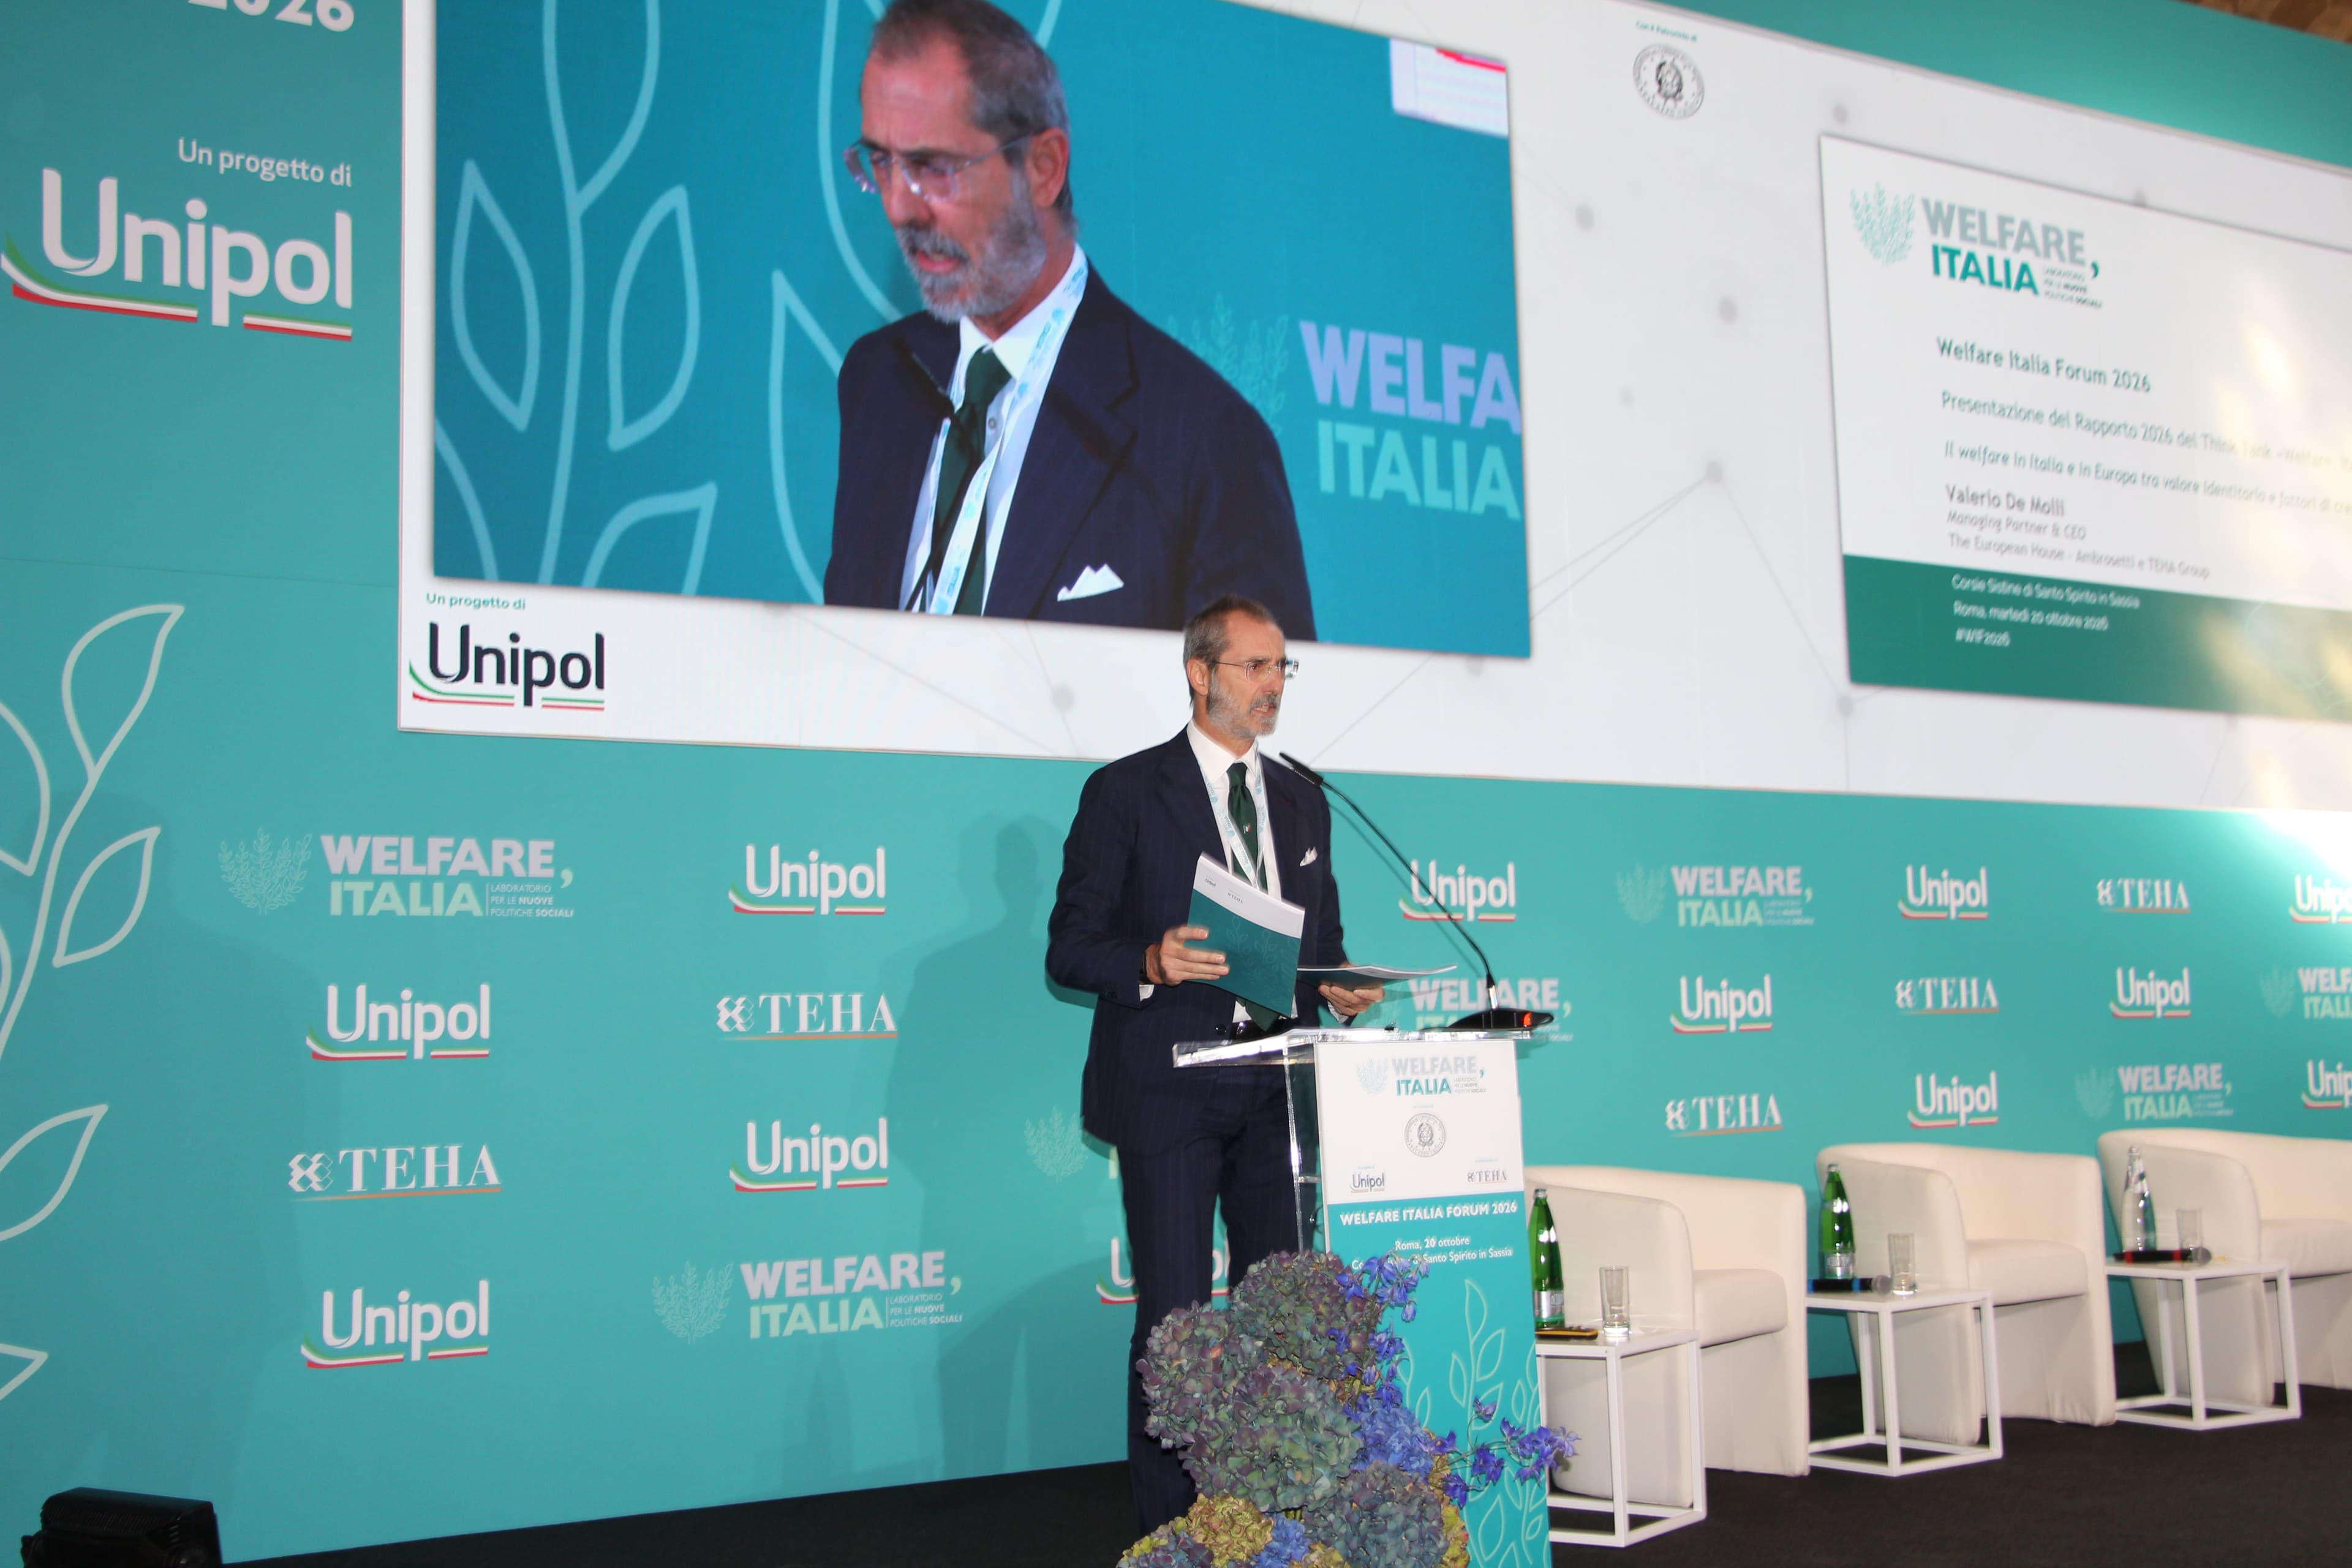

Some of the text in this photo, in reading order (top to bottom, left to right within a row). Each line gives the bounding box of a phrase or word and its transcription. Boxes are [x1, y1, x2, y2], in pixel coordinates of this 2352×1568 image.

[179, 137, 352, 187] Un progetto di
[42, 167, 352, 326] Unipol
[1932, 243, 2040, 296] ITALIA
[1937, 337, 2151, 393] Welfare Italia Forum 2026
[1942, 391, 2044, 425] Presentazione
[2049, 407, 2071, 429] del
[2075, 412, 2138, 441] Rapporto
[2177, 429, 2198, 450] del
[1317, 419, 1521, 521] ITALIA
[1958, 443, 2009, 467] welfare
[2013, 451, 2026, 467] in
[2029, 454, 2064, 475] Italia
[2067, 464, 2075, 476] e
[2079, 461, 2091, 478] in
[2095, 462, 2138, 487] Europa
[2141, 471, 2160, 488] tra
[2163, 475, 2199, 494] valore
[1947, 484, 2065, 518] Valerio De Molli
[1947, 510, 2002, 533] Managing
[2005, 516, 2047, 537] Partner
[2064, 522, 2086, 540] CEO
[1948, 533, 1970, 551] The
[1975, 536, 2027, 560] European
[426, 593, 526, 610] Un progetto di
[429, 622, 605, 707] Unipol
[491, 883, 551, 892] LABORATORIO
[746, 843, 885, 915] Unipol
[1411, 859, 1516, 922] Unipol
[1906, 864, 1988, 920] Unipol
[2117, 878, 2190, 908] TEHA
[330, 881, 483, 917] ITALIA
[491, 908, 532, 917] POLITICHE
[507, 896, 516, 905] LE
[1678, 899, 1764, 927] ITALIA
[1679, 973, 1773, 1033] Unipol
[1918, 977, 1999, 1009] TEHA
[2116, 966, 2190, 1018] Unipol
[327, 983, 489, 1059] Unipol
[759, 993, 898, 1034] TEHA
[1396, 1078, 1452, 1096] ITALIA
[1915, 1070, 1998, 1126] Unipol
[1692, 1093, 1783, 1130] TEHA
[2124, 1093, 2192, 1121] ITALIA
[339, 1144, 502, 1192] TEHA
[747, 1116, 888, 1189] Unipol
[1352, 1170, 1385, 1191] Unipol
[1476, 1169, 1508, 1182] TEHA
[1340, 1200, 1518, 1226] WELFARE ITALIA FORUM 2026
[1395, 1236, 1470, 1251] Roma, 20 ottobre
[1423, 1254, 1447, 1264] Santo
[1449, 1250, 1477, 1264] Spirito
[1479, 1249, 1487, 1260] in
[1488, 1246, 1513, 1258] Sassia
[890, 1293, 943, 1304] LABORATORIO
[914, 1304, 944, 1314] NUOVE
[322, 1279, 489, 1361] Unipol
[750, 1297, 883, 1339] ITALIA
[890, 1314, 962, 1327] POLITICHE SOCIALI
